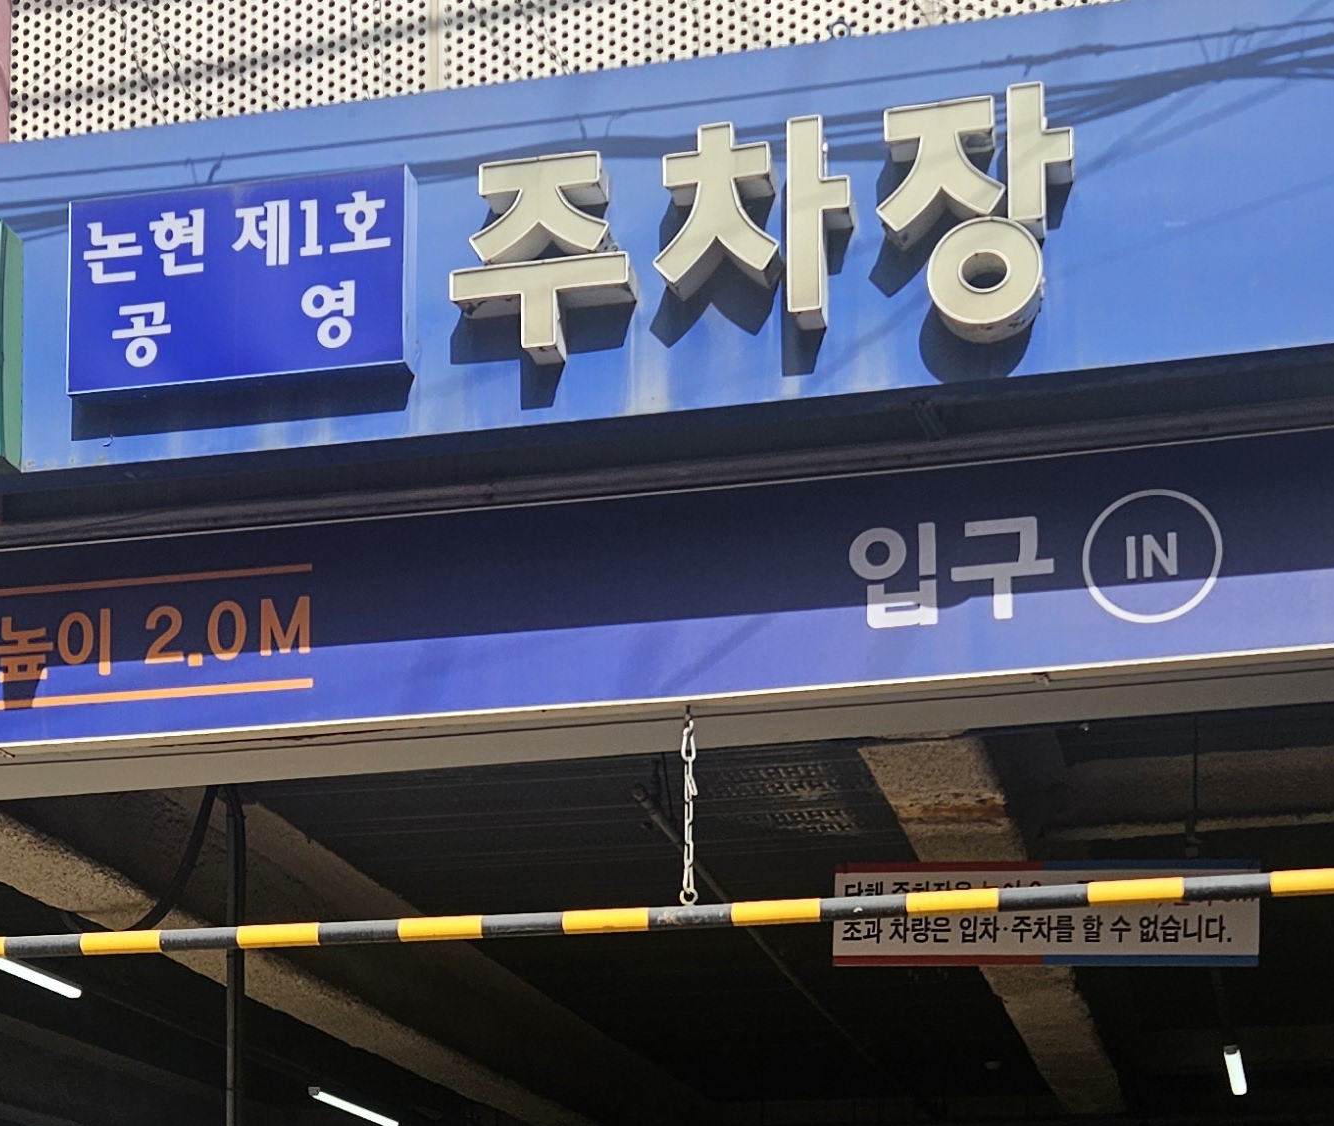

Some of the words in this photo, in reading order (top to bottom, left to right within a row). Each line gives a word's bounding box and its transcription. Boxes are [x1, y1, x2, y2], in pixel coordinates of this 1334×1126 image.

[82, 207, 208, 285] 논현
[231, 189, 392, 268] 제1호
[449, 80, 1075, 366] 주차장
[848, 514, 1055, 630] 입구
[1124, 532, 1178, 580] IN
[145, 595, 313, 668] 2.0M
[889, 916, 951, 943] 차량은
[1083, 915, 1103, 943] 할
[1110, 915, 1131, 943] 수
[1139, 914, 1232, 943] 없습니다.
